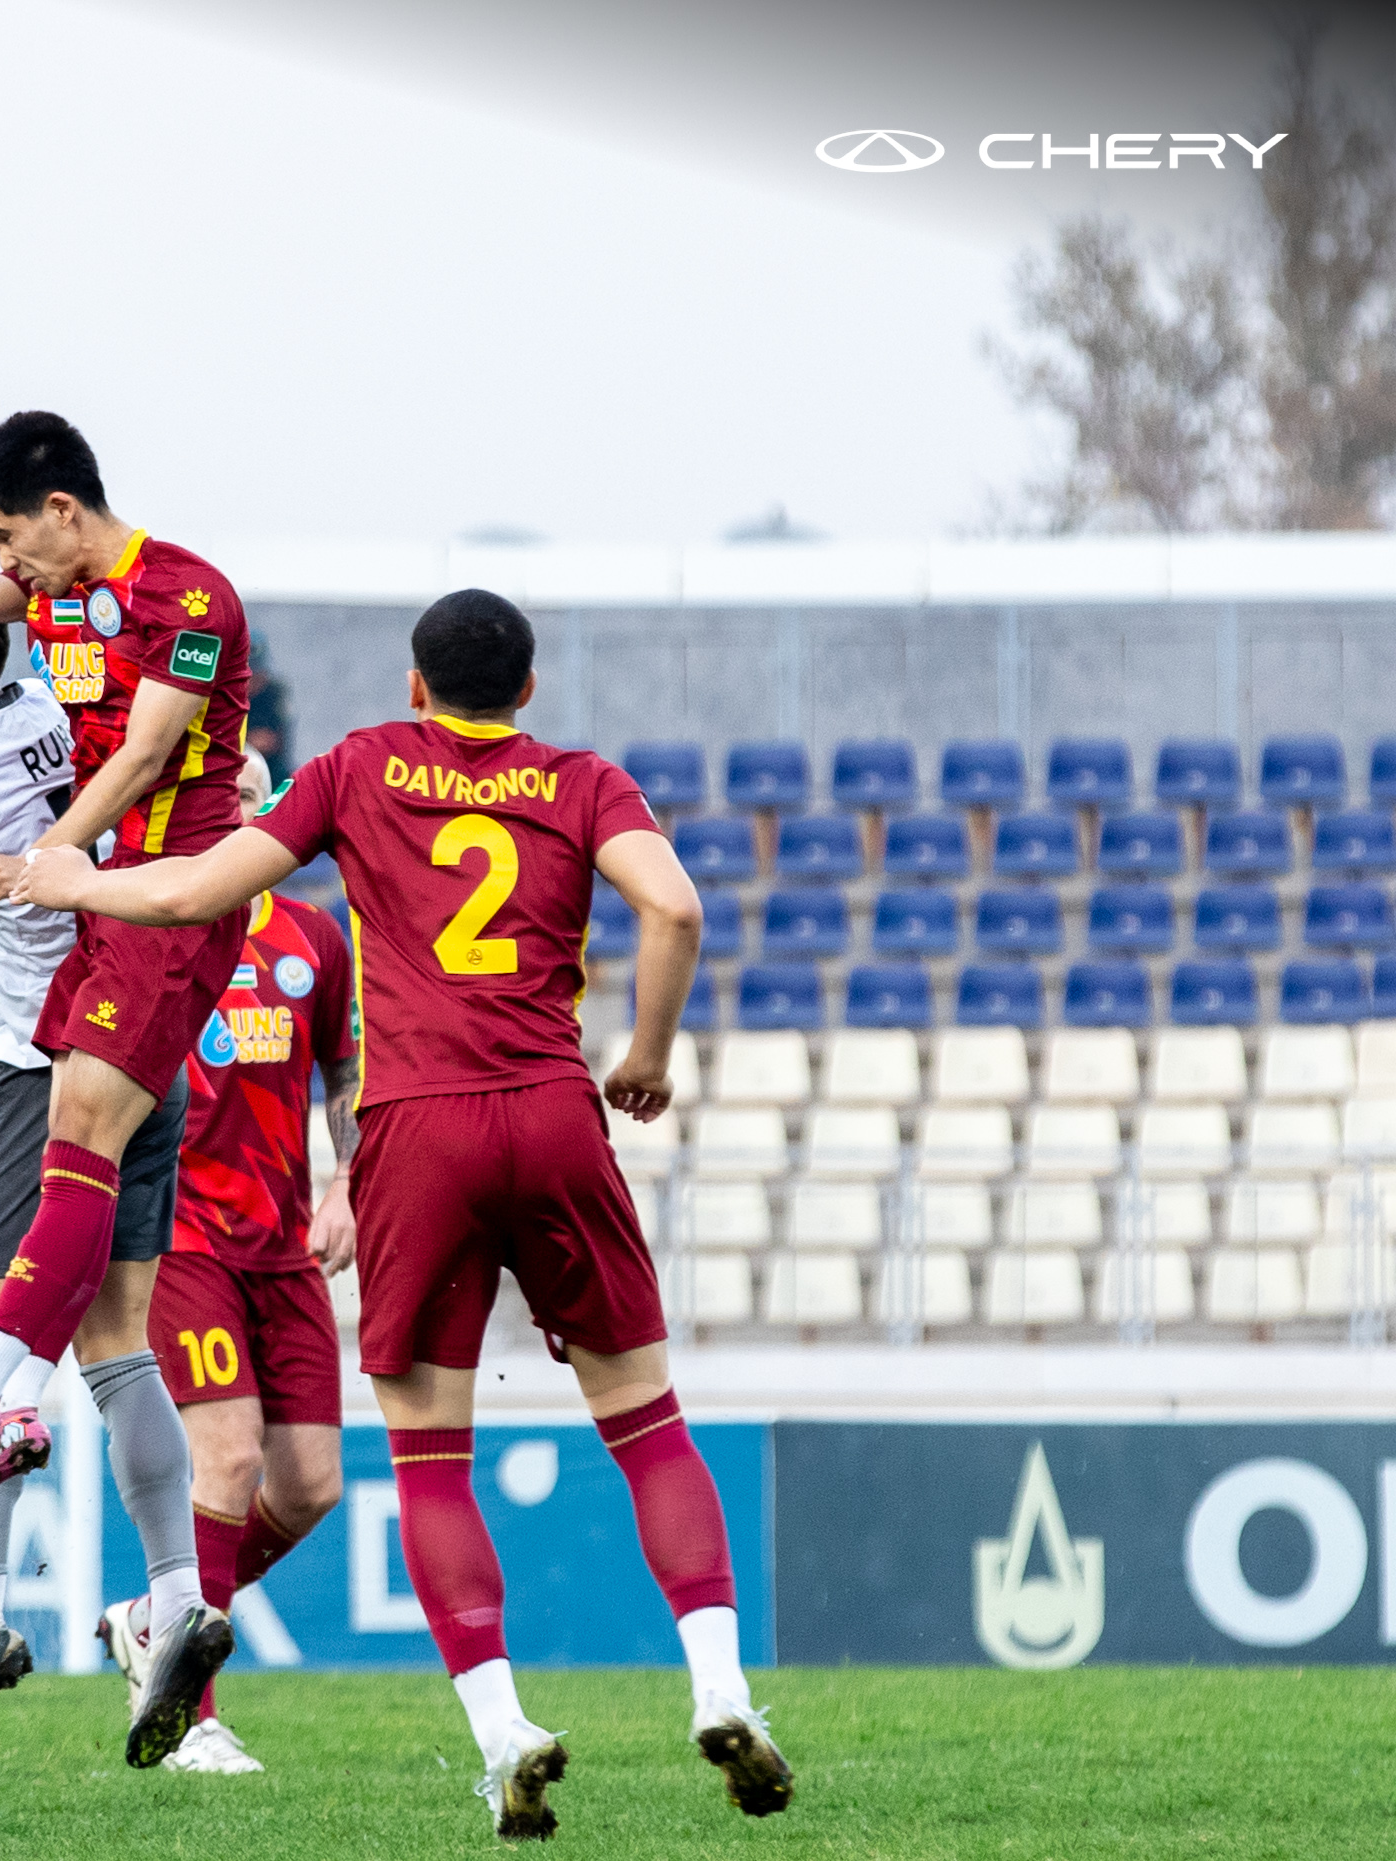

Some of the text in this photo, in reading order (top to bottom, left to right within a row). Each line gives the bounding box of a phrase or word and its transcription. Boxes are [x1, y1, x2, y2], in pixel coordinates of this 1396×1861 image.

[50, 642, 105, 678] UNG
[177, 648, 214, 666] artel
[53, 676, 105, 704] SGCC
[384, 756, 557, 805] DAVRONOV
[431, 813, 519, 975] 2
[229, 1005, 294, 1039] UNG
[177, 1326, 239, 1388] 10
